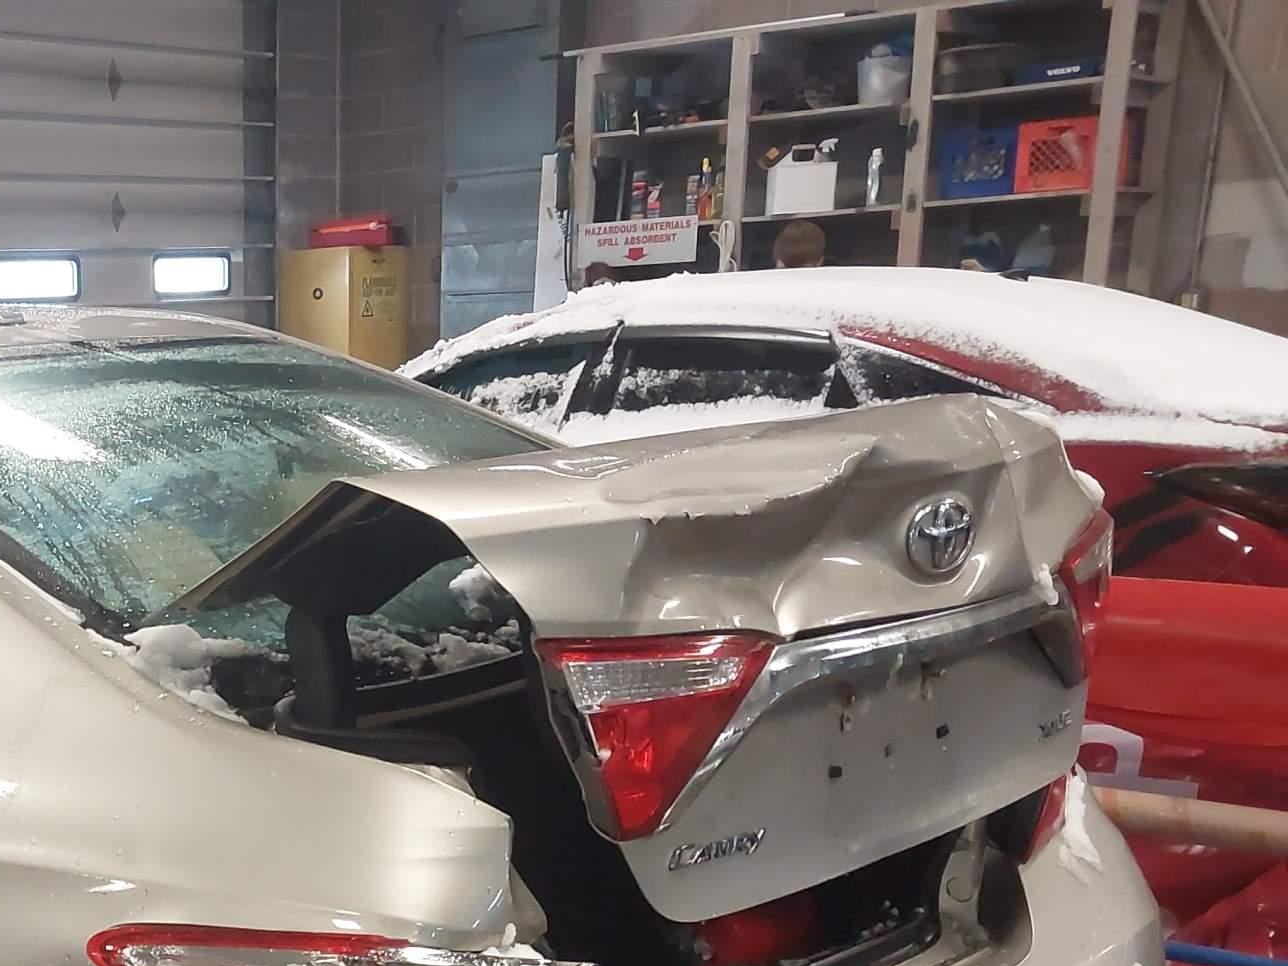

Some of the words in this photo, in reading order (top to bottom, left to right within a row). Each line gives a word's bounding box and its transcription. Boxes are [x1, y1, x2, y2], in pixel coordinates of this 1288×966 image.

[584, 223, 637, 236] HAZARDOUS
[641, 219, 691, 232] MATERIALS
[597, 236, 619, 248] SPILL
[624, 233, 677, 246] ABSORBENT
